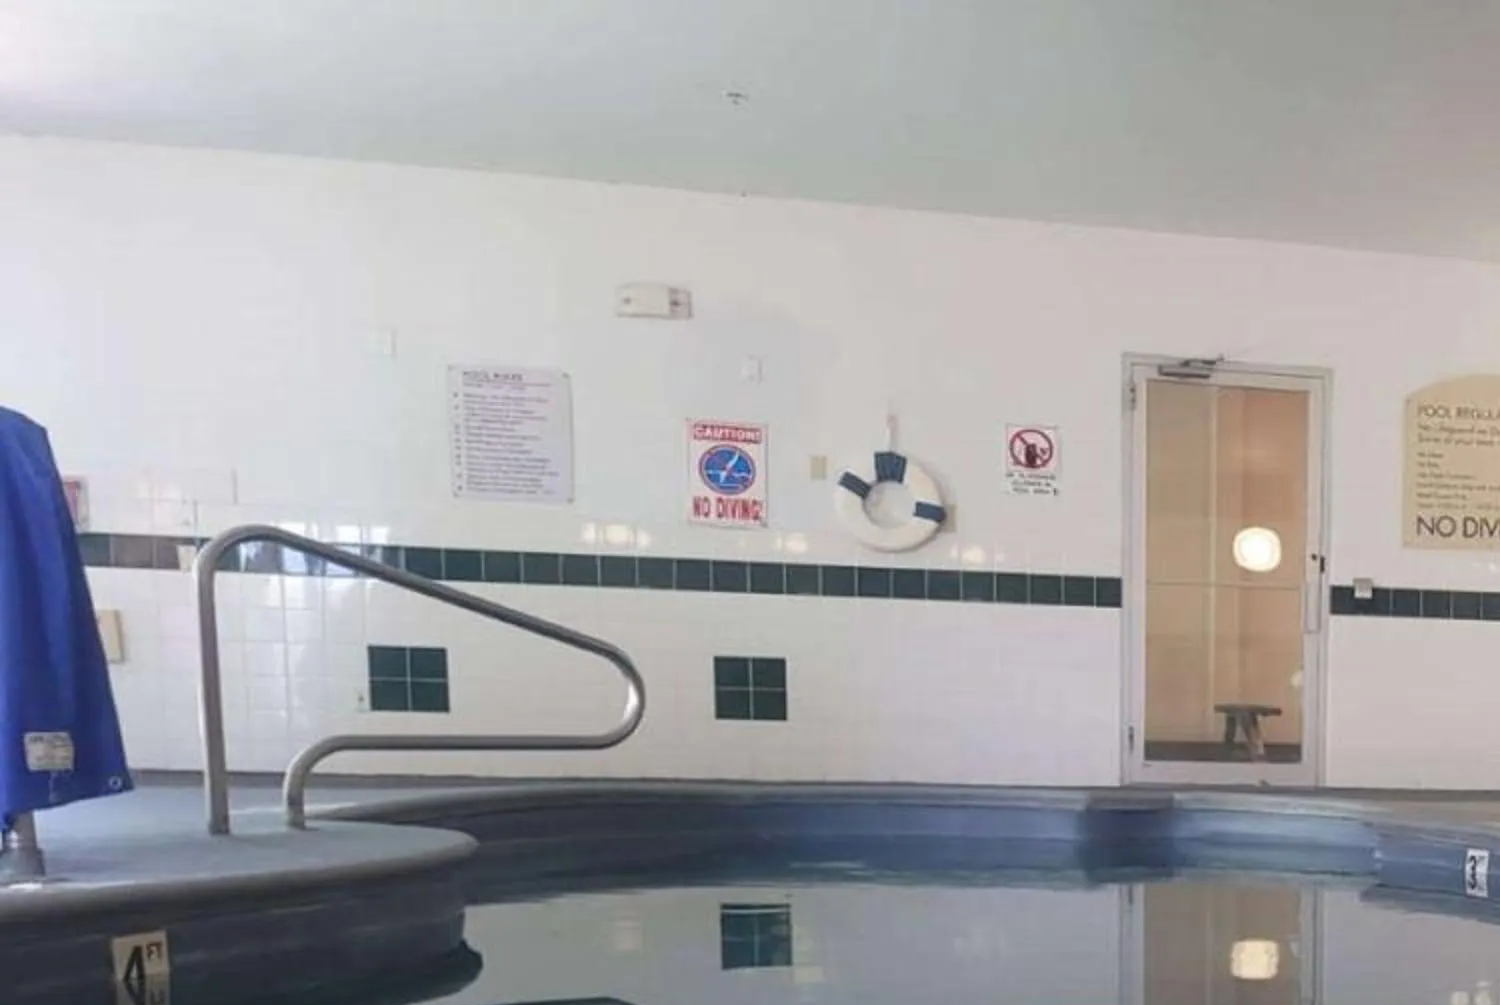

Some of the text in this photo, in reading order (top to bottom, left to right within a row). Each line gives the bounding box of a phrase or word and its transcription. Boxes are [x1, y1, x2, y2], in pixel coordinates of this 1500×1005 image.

[1417, 404, 1452, 418] POOL
[693, 496, 711, 519] NO
[1416, 514, 1457, 539] NO
